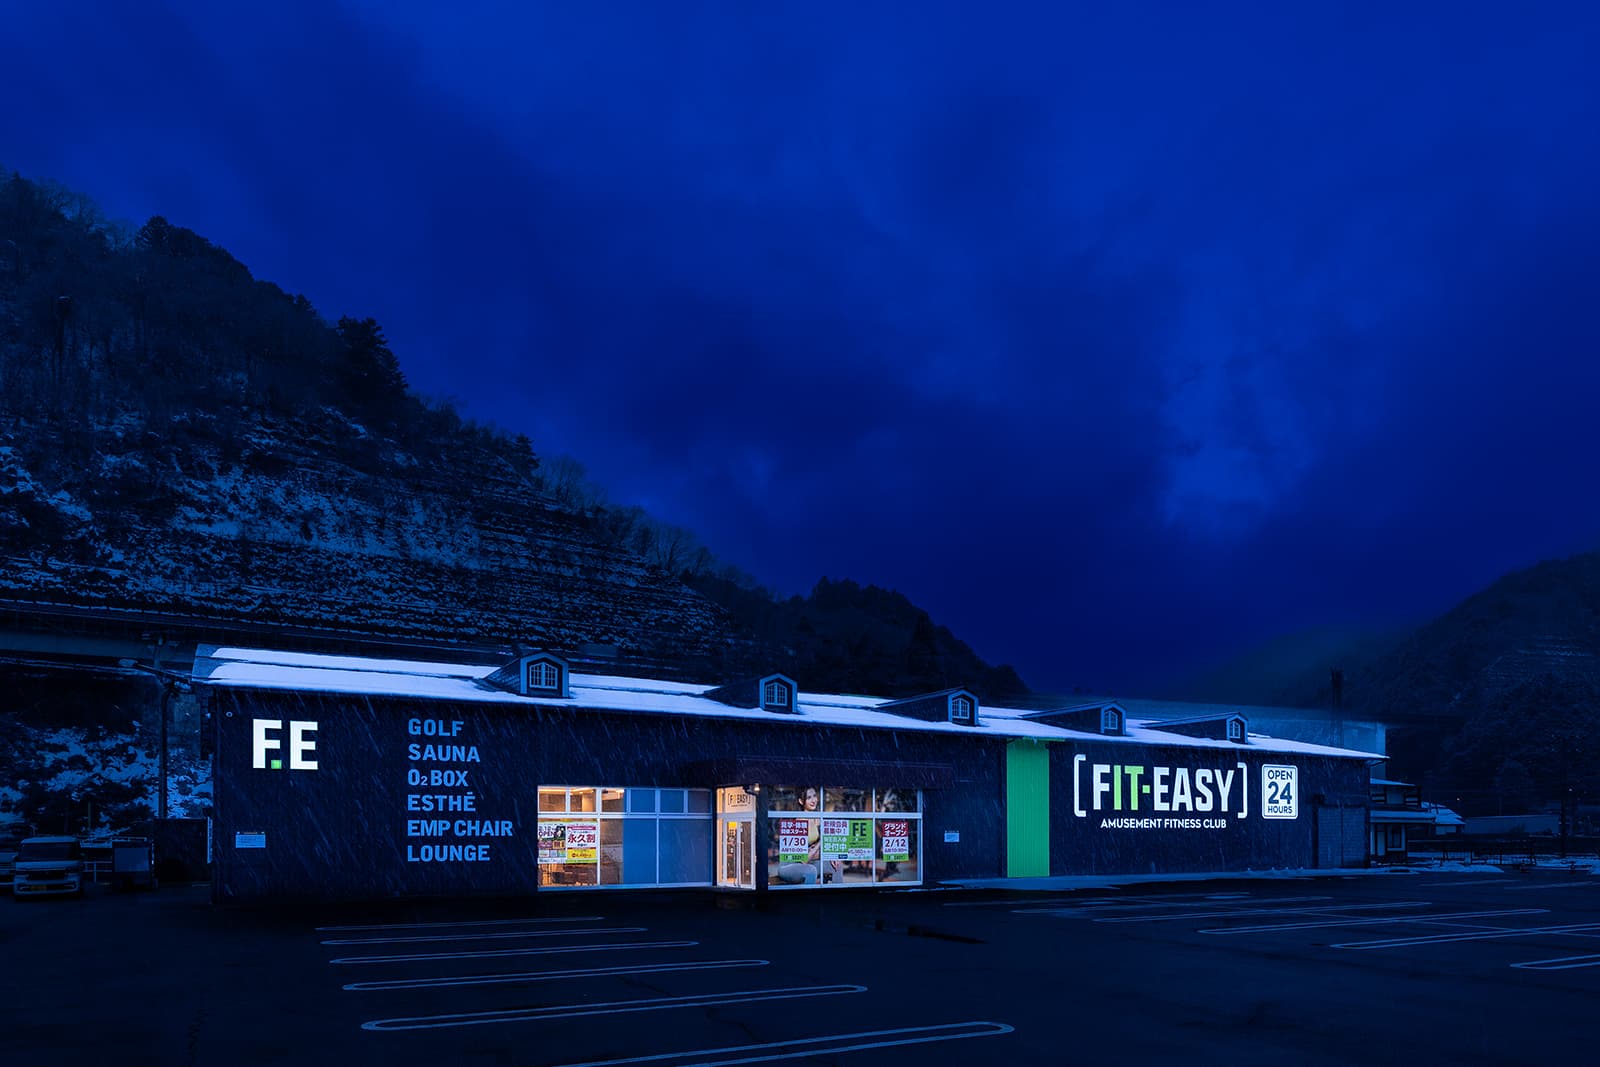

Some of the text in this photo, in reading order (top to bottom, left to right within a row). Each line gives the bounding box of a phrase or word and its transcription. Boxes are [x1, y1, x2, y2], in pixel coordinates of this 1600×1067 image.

[408, 718, 464, 736] GOLF
[408, 743, 480, 762] SAUNA
[430, 769, 468, 786] BOX
[1267, 769, 1293, 780] OPEN
[1268, 781, 1293, 805] 24
[1267, 805, 1293, 814] HOURS
[407, 820, 513, 836] EMP CHAIR
[1100, 818, 1227, 829] AMUSEMENT FITNESS CLUB
[568, 833, 596, 843] 永久割
[782, 837, 806, 847] 1/30
[884, 839, 906, 848] 2/12
[407, 845, 490, 861] LOUNGE
